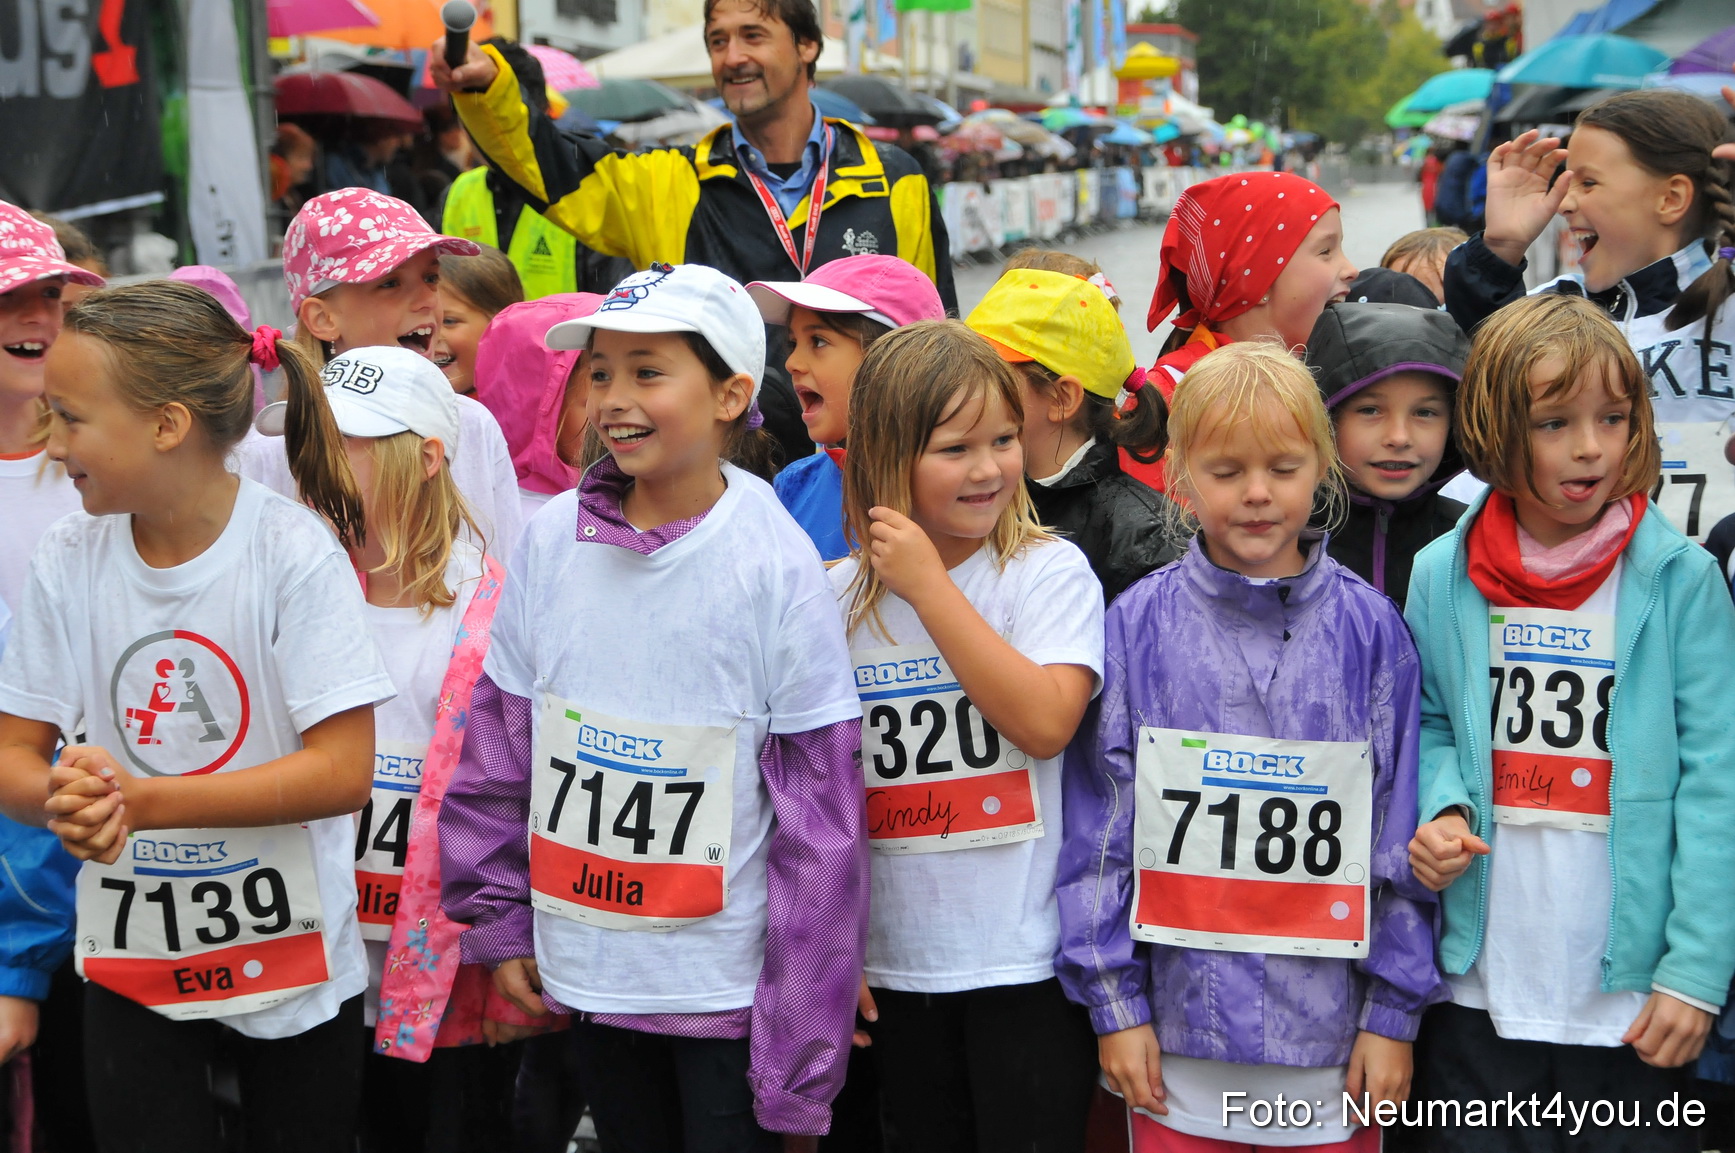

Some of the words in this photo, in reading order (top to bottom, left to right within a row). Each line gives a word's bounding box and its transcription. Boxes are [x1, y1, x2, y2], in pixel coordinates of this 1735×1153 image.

[1503, 624, 1592, 651] BOCK
[853, 656, 942, 687] BOCK
[1489, 666, 1615, 753] 7338
[578, 724, 663, 761] BOCK
[869, 694, 1001, 780] 320
[1203, 749, 1305, 778] BOCK
[547, 756, 705, 856] 7147
[866, 790, 960, 840] Cindy
[1161, 788, 1342, 876] 7188
[133, 839, 228, 864] BOCK
[707, 846, 720, 861] W
[572, 863, 644, 906] Julia
[101, 867, 292, 952] 7139
[302, 919, 315, 930] W
[174, 966, 234, 995] Eva
